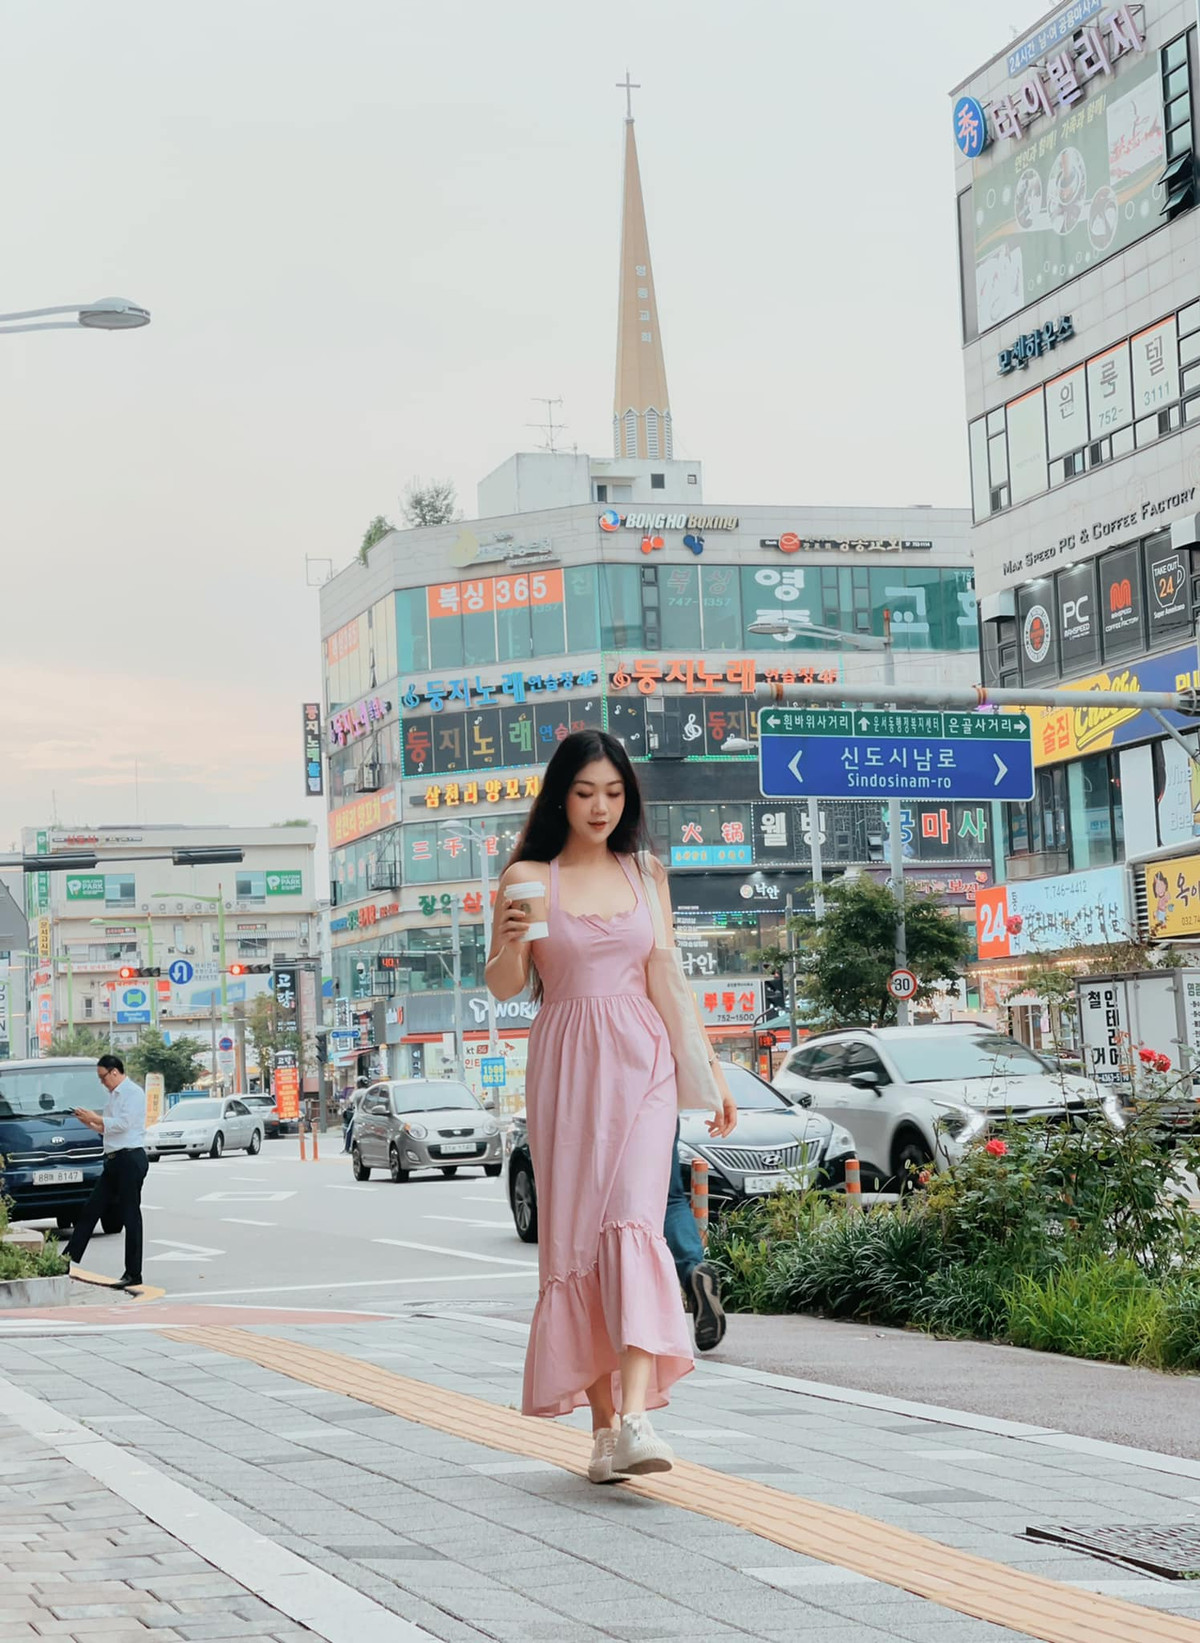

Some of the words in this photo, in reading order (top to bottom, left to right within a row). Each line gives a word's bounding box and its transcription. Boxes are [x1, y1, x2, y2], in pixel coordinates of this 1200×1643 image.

[1009, 41, 1035, 73] 24시간
[959, 104, 978, 153] 秀
[625, 513, 687, 529] BONGHO
[1059, 535, 1075, 553] PC
[1079, 529, 1089, 543] &
[1154, 565, 1168, 577] TAKE
[1166, 561, 1178, 572] OUT
[438, 582, 484, 612] 복싱
[497, 576, 546, 604] 365
[667, 569, 733, 596] 복싱
[1159, 578, 1174, 599] 24
[1063, 595, 1089, 628] PC
[632, 659, 756, 694] 둥지노래
[764, 667, 814, 684] 연습장
[425, 671, 527, 712] 둥지노래
[527, 671, 573, 693] 연습장
[783, 714, 849, 730] 흰바위사거리
[949, 717, 1012, 735] 은골사거리
[405, 719, 533, 763] 둥지노래
[1043, 713, 1070, 756] 술집
[840, 747, 957, 771] 신도시남로
[847, 773, 952, 789] Sindosinam-ro
[682, 821, 745, 844] 火锅
[980, 902, 1006, 942] 24
[894, 978, 910, 991] 30
[704, 991, 755, 1013] 부동산
[717, 1013, 755, 1022] 752-1500
[466, 1047, 475, 1055] kt
[58, 1171, 79, 1181] 8147
